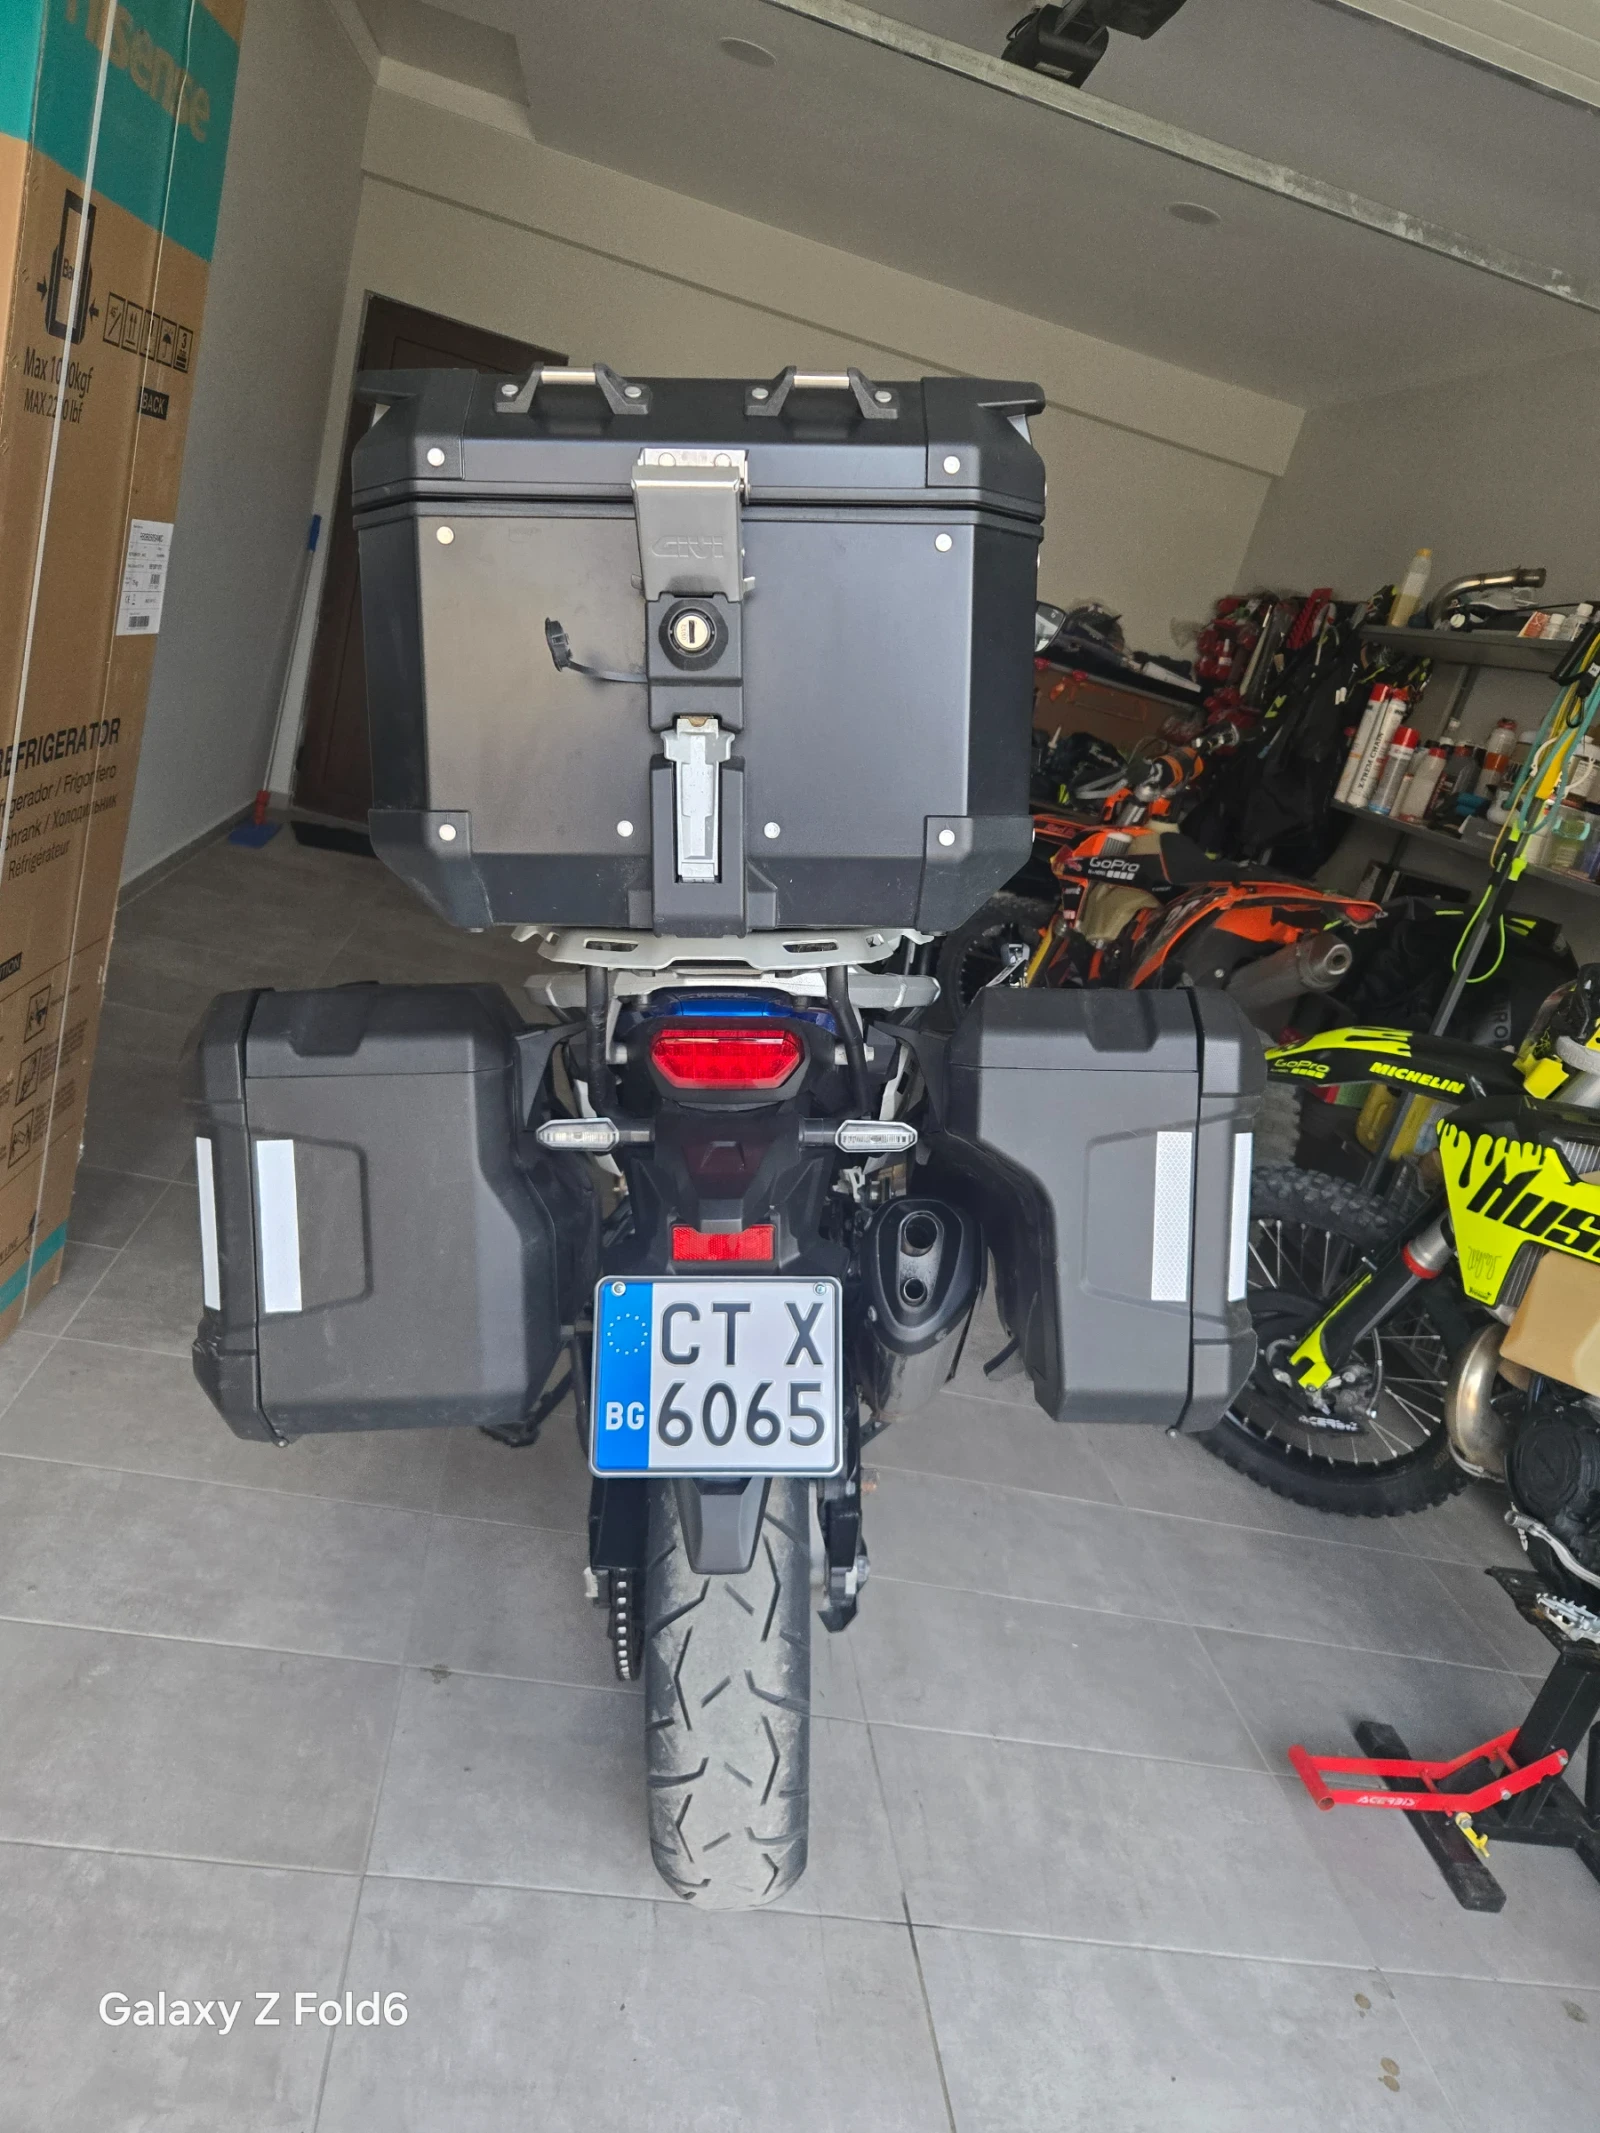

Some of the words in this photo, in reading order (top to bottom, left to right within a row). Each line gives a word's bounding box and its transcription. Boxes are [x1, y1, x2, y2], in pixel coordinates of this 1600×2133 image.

[23, 346, 48, 381] Max
[24, 388, 47, 415] MAX
[141, 392, 165, 415] BACK
[651, 535, 724, 559] GIVI
[1371, 732, 1385, 759] CHAIN
[1088, 856, 1141, 873] GoPro
[1273, 1058, 1332, 1074] GoPro
[1369, 1061, 1466, 1095] MICHELIN
[1466, 1155, 1600, 1259] HUS
[661, 1302, 752, 1366] CT
[785, 1302, 825, 1366] X
[605, 1401, 646, 1431] BG
[657, 1381, 826, 1447] 6065
